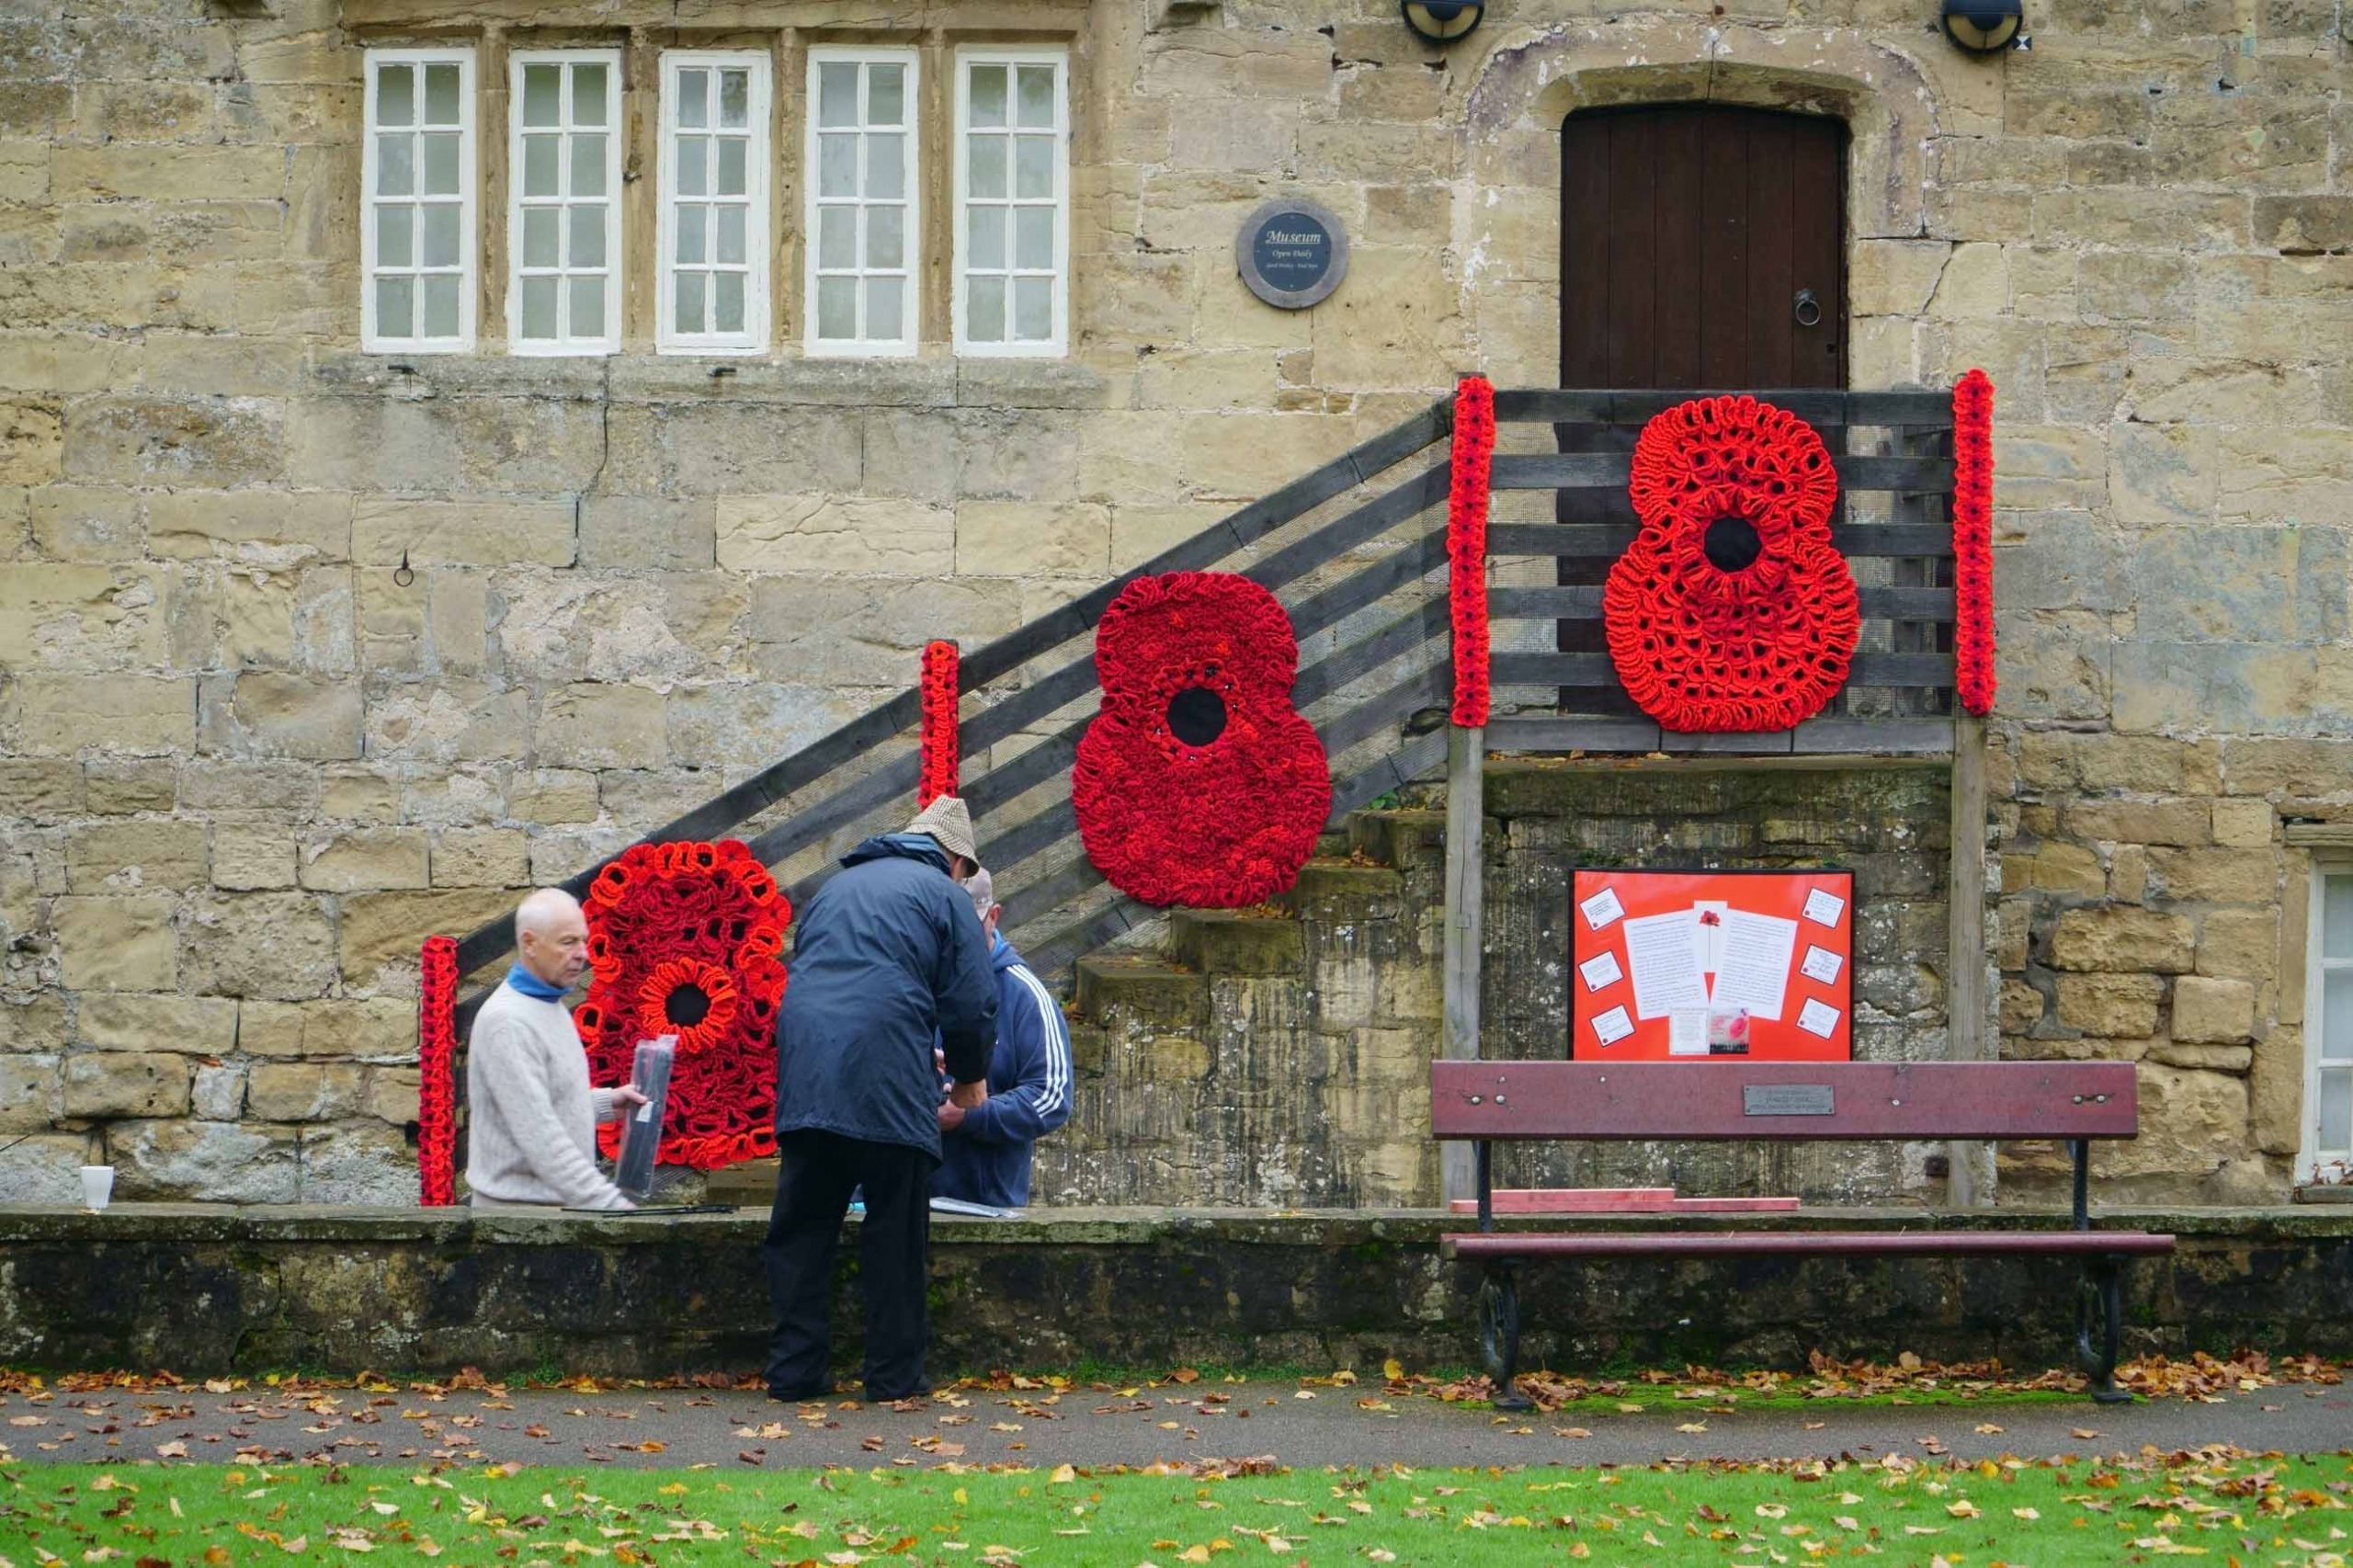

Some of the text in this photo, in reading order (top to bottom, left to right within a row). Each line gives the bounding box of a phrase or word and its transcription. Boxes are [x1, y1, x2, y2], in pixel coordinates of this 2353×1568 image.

[1266, 230, 1321, 244] Museum
[1272, 249, 1312, 259] Open Daily
